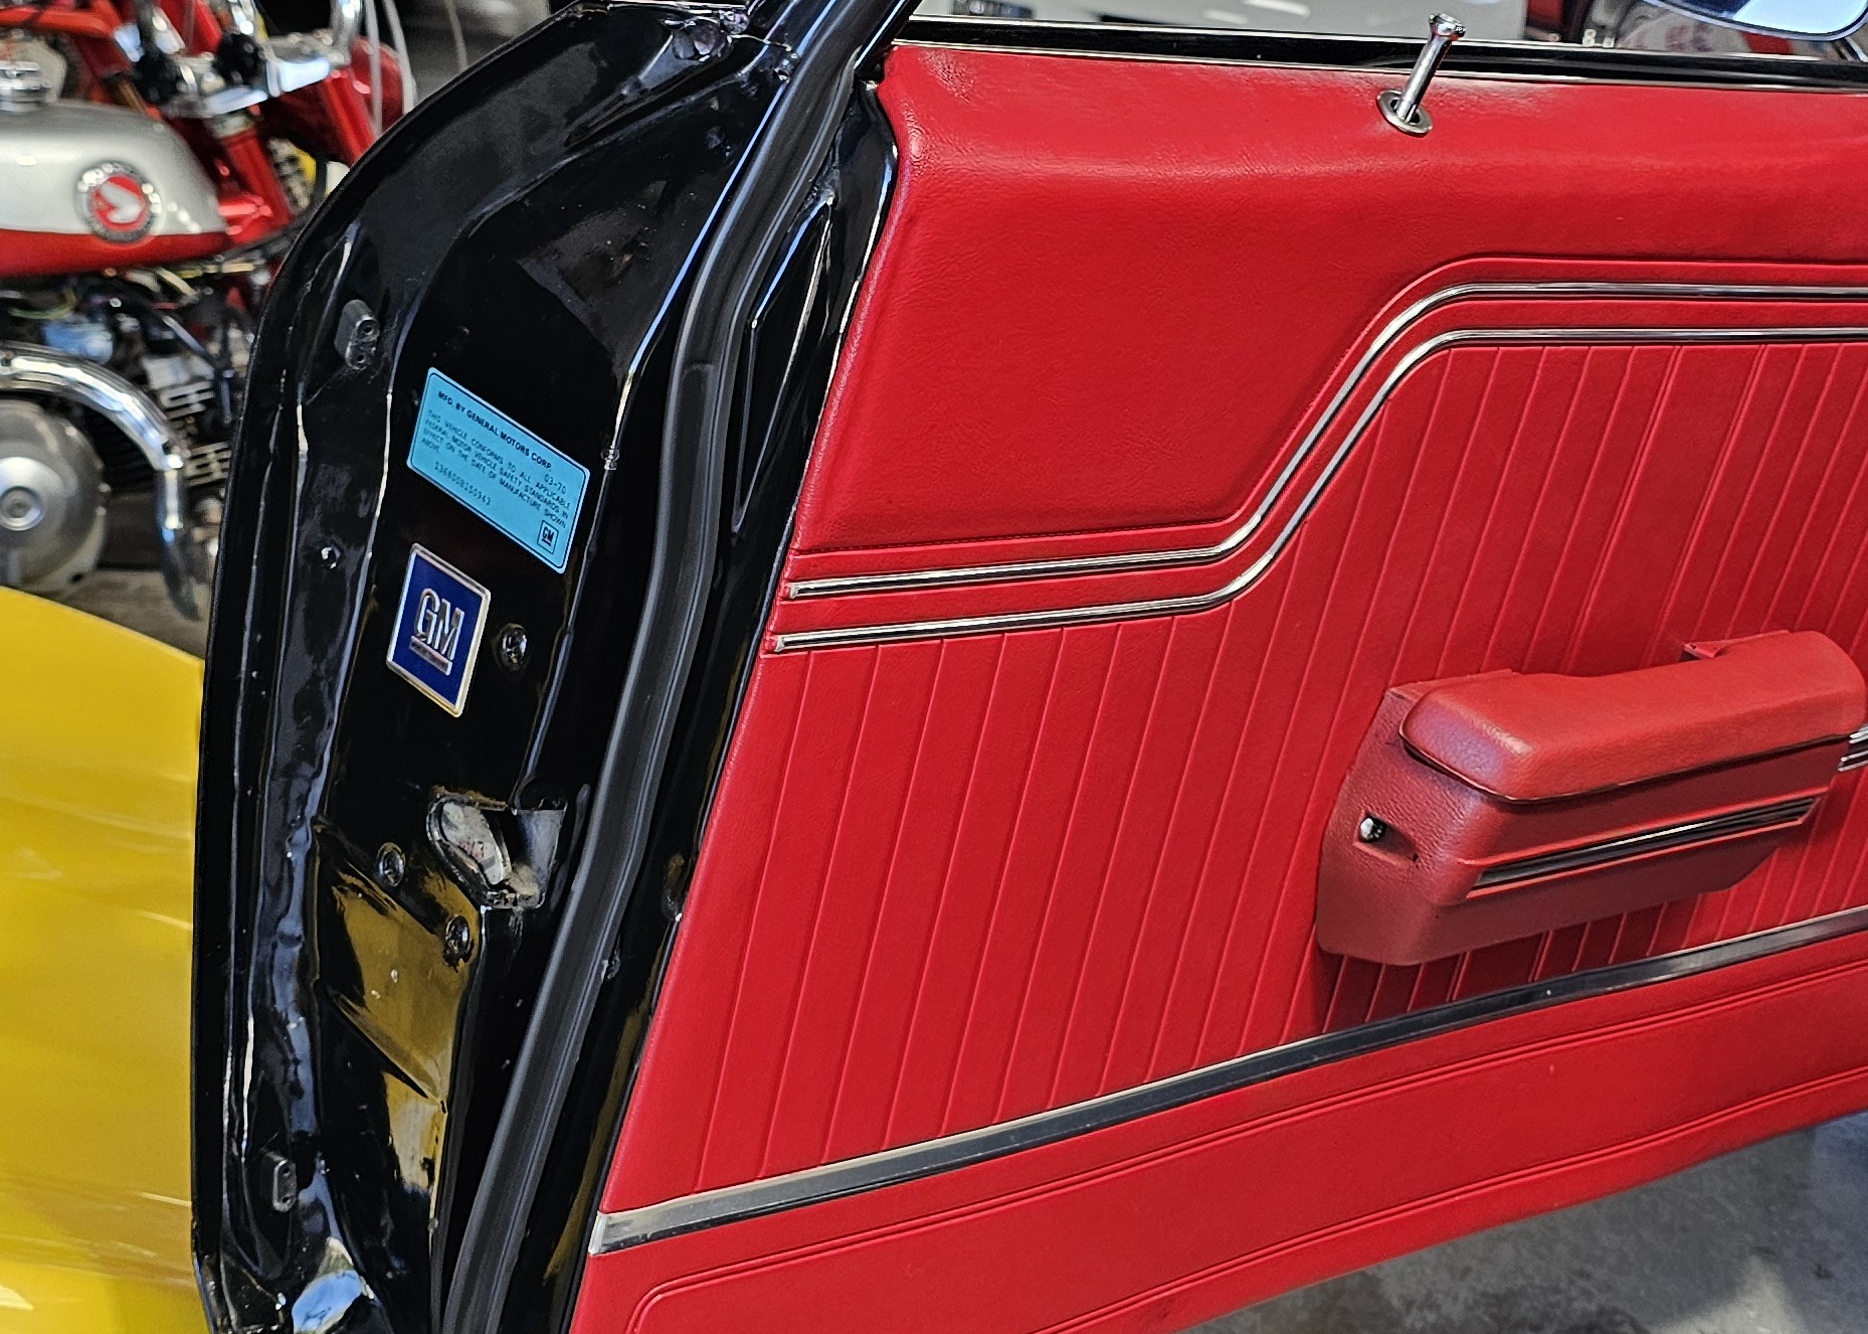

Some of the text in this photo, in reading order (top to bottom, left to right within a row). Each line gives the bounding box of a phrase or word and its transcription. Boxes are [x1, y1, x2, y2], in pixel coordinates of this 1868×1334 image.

[455, 401, 465, 414] BY
[466, 408, 498, 436] GENERAL
[499, 431, 529, 456] MOTORS
[445, 441, 455, 453] ON
[470, 458, 485, 474] DATE
[498, 477, 541, 511] MANUFACTURE
[543, 507, 566, 528] SHOWN
[499, 467, 522, 488] SAFETY
[523, 483, 560, 514] STANDARDS
[507, 462, 516, 474] TO
[519, 470, 531, 484] ALL
[535, 480, 570, 510] APPLICABLE
[543, 473, 566, 495] 03-70
[542, 527, 556, 544] GM
[414, 587, 465, 660] GM
